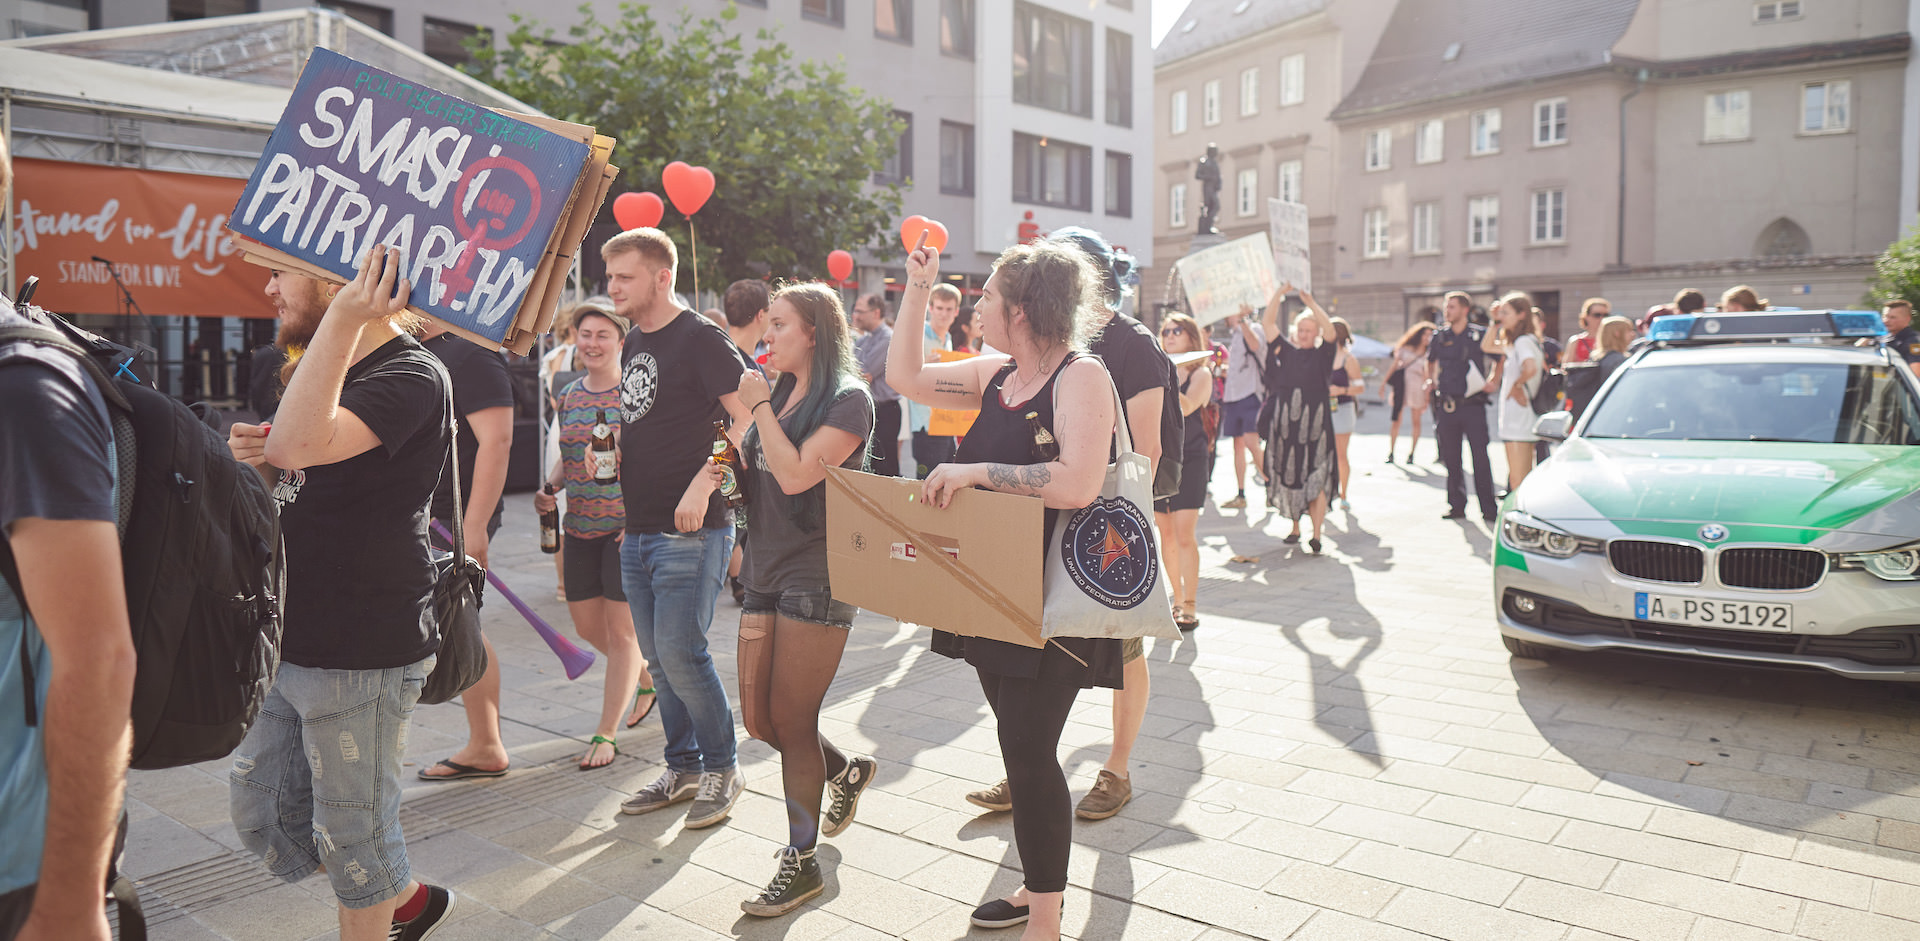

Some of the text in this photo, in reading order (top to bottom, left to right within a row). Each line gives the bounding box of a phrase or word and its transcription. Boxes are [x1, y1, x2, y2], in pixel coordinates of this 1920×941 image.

[355, 71, 548, 150] POLITISCHER STREIK
[124, 218, 154, 244] for
[58, 260, 182, 288] STAND FOR LOVE
[1066, 557, 1086, 586] UNITED
[1131, 592, 1142, 603] OF
[1141, 558, 1156, 594] PLANETS
[1651, 598, 1787, 629] A PS 5192
